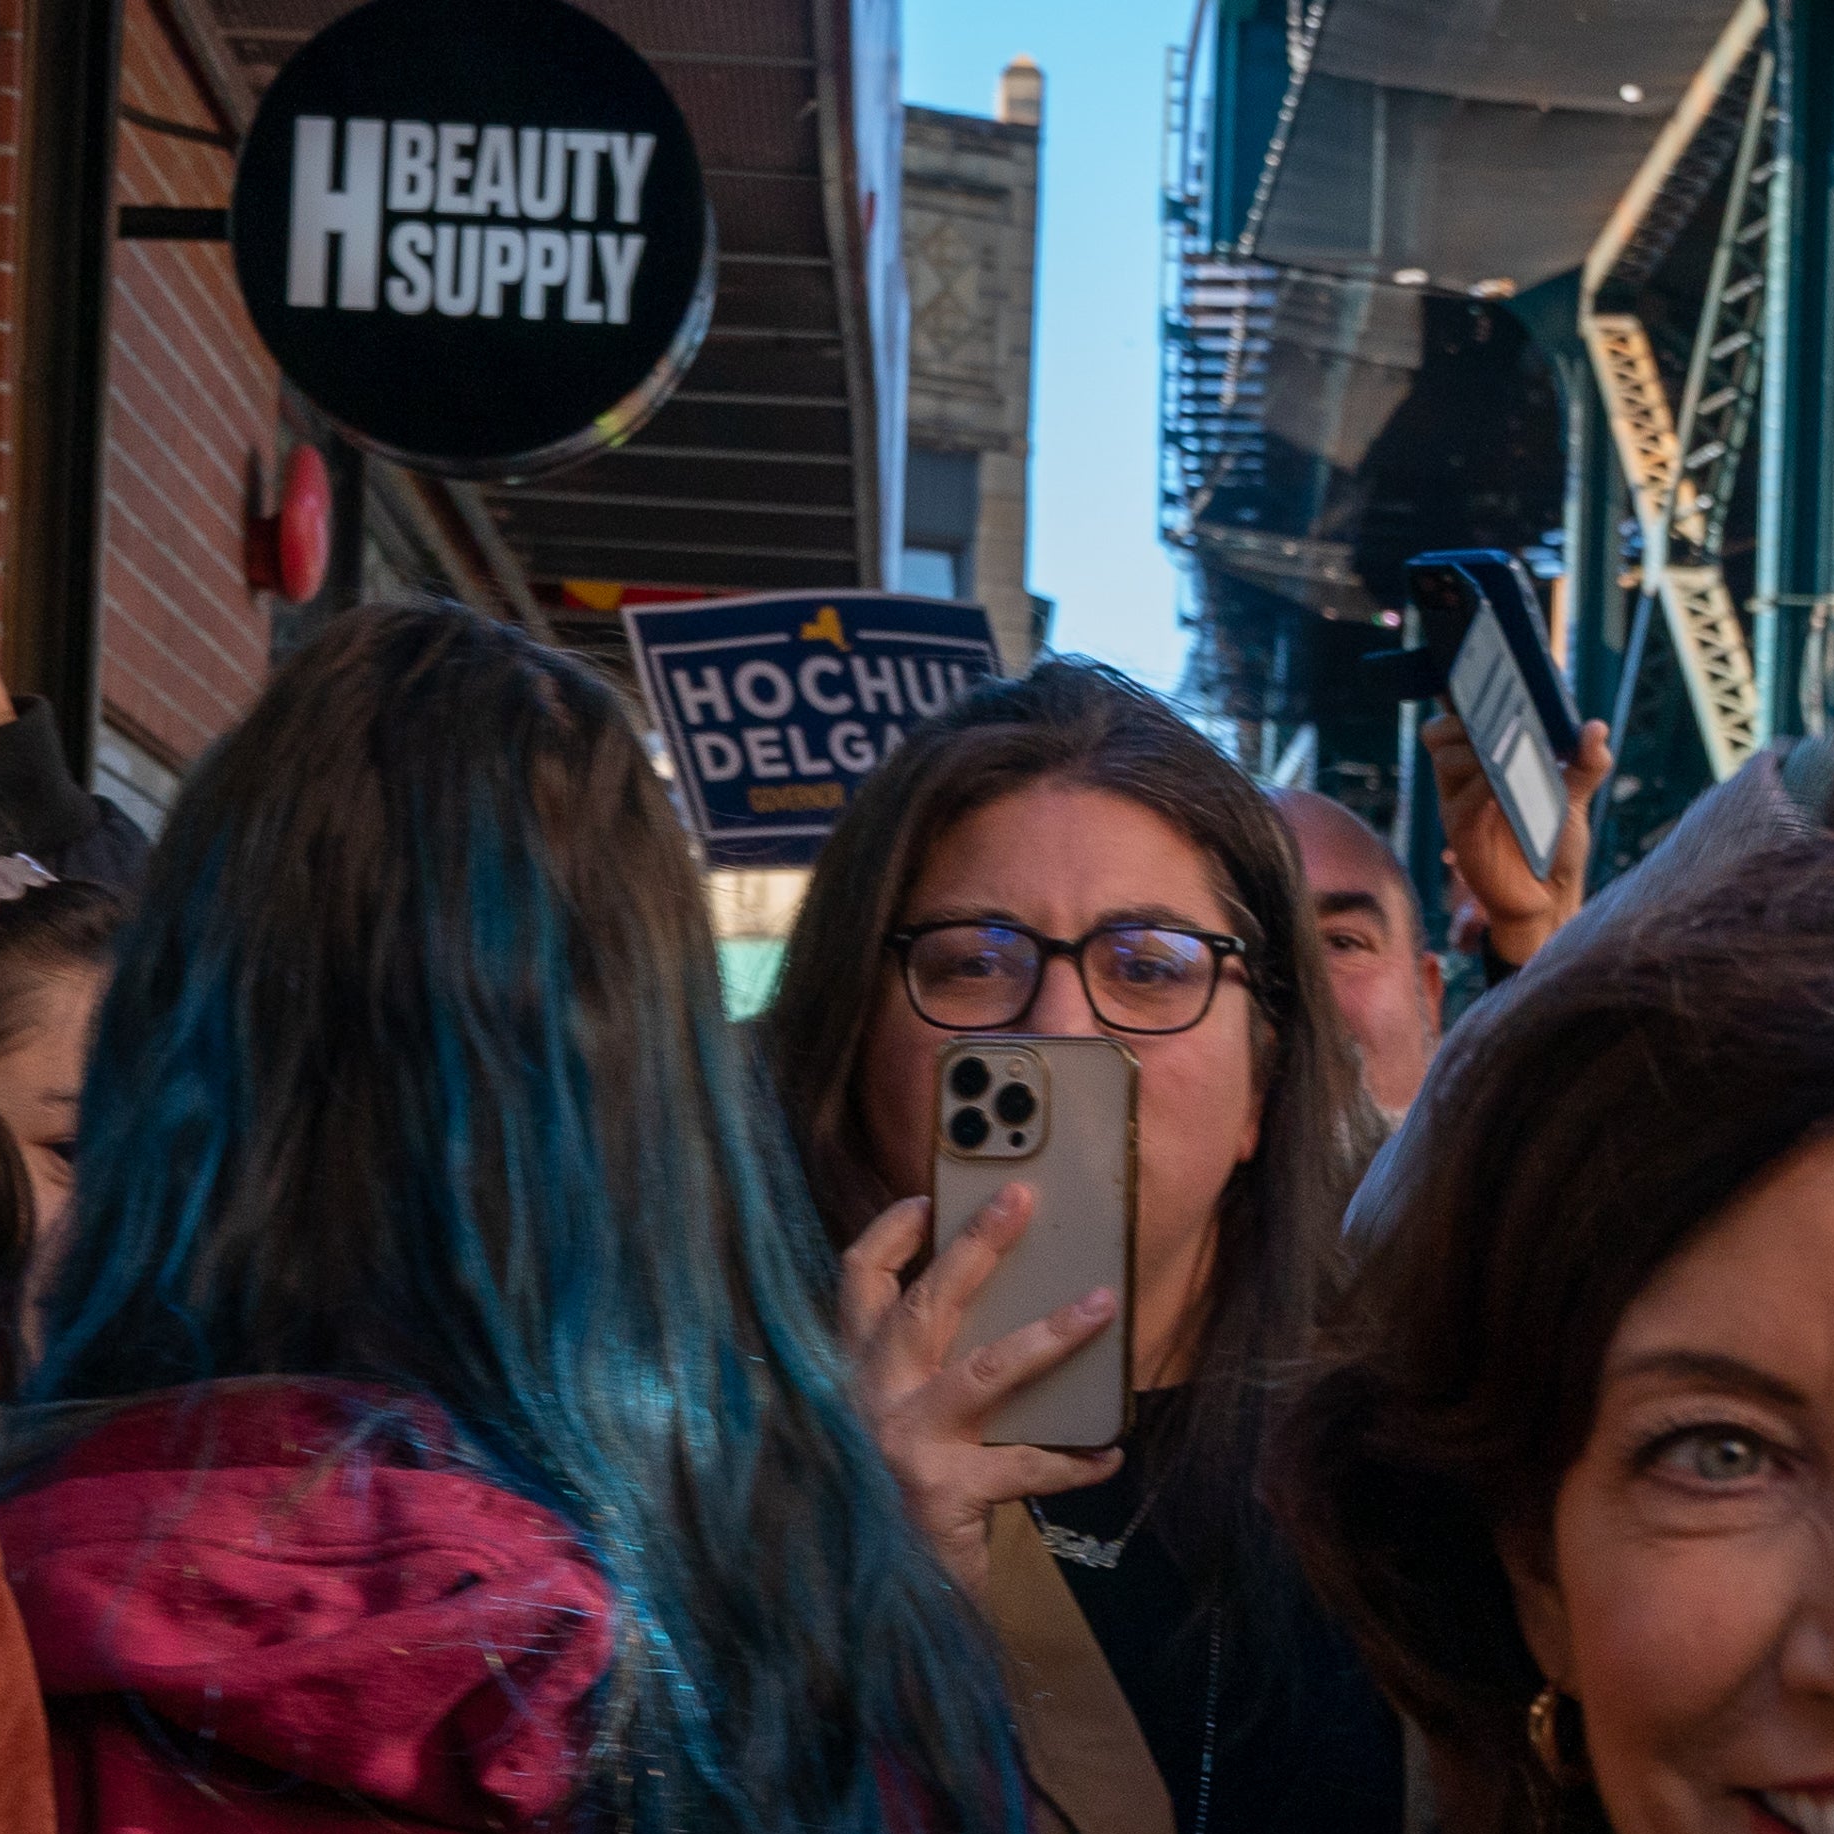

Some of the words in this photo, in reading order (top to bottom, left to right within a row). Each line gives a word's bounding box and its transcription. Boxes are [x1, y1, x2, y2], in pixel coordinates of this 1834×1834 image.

[286, 115, 385, 313] H
[387, 119, 657, 226] BEAUTY
[385, 223, 648, 326] SUPPLY
